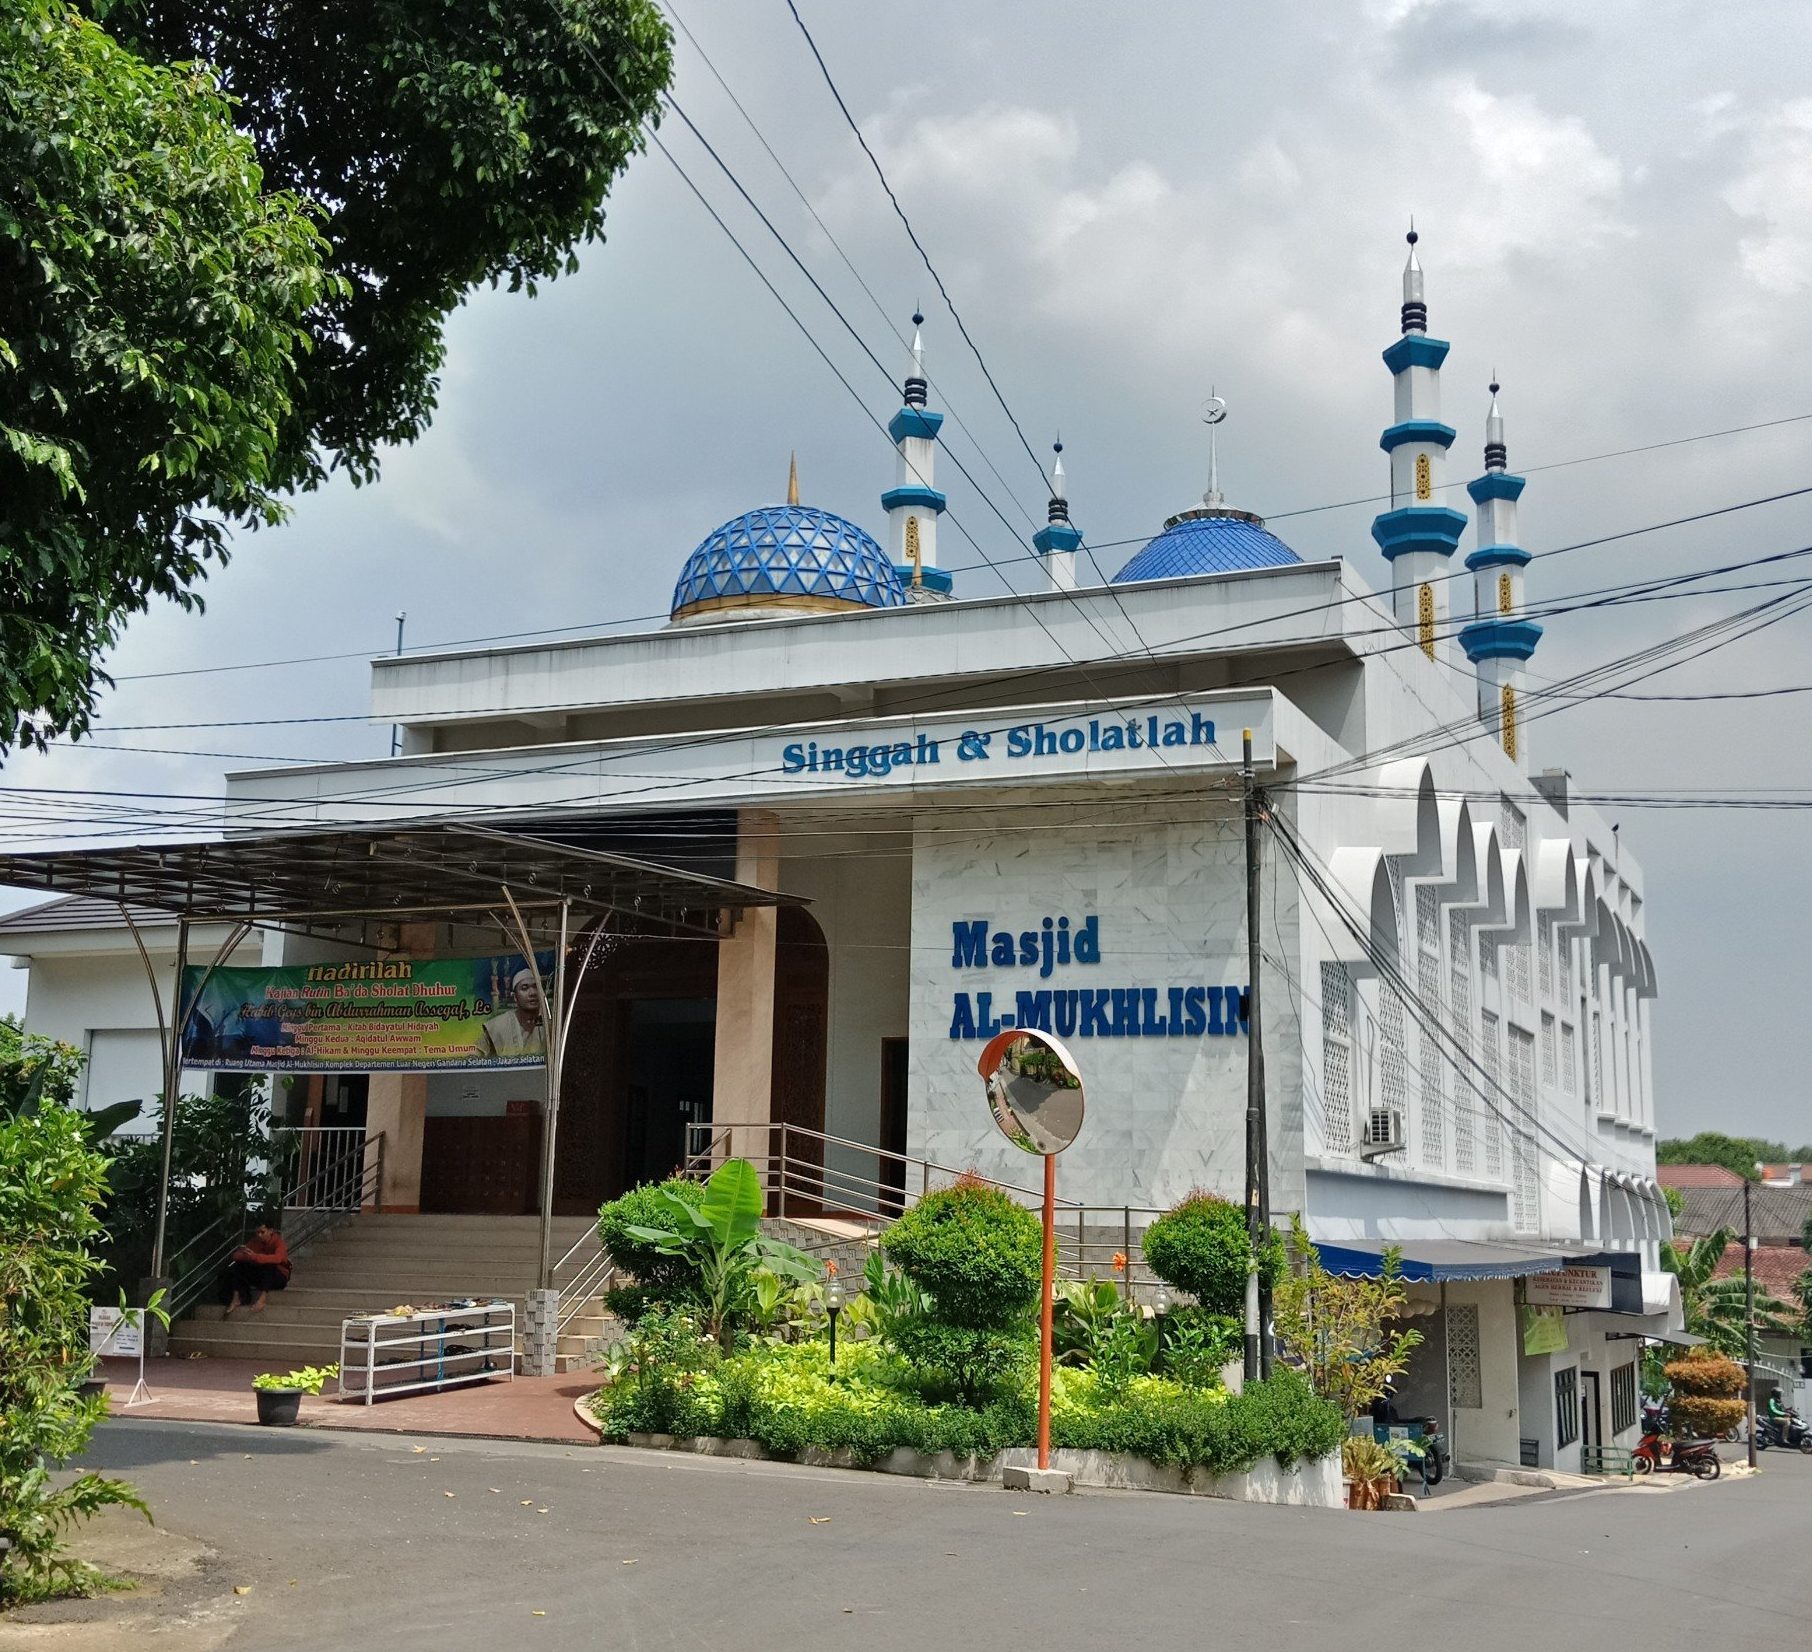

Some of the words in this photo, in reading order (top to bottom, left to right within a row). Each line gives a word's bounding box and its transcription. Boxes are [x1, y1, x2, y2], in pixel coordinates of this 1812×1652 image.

[783, 734, 939, 777] Singgah
[957, 731, 991, 762] &
[1008, 712, 1217, 758] Sholatlah
[952, 915, 1101, 978] Masjid
[266, 985, 300, 1001] Kajian
[302, 985, 330, 998] Rutin
[371, 983, 410, 997] Sholat
[412, 982, 457, 996] Dhuhur
[950, 985, 1250, 1039] AL-MUKHLISIN
[308, 1023, 341, 1032] Pertama
[347, 1023, 367, 1031] Kitab
[368, 1022, 405, 1032] Bidayatul
[407, 1022, 439, 1032] Hidayah
[296, 1035, 323, 1045] Minggu
[325, 1035, 349, 1043] Kedua
[356, 1034, 387, 1044] Aqidatul
[389, 1034, 421, 1043] Awwam
[306, 1045, 341, 1055] Al-Hikam
[351, 1046, 379, 1056] Minggu
[382, 1046, 416, 1056] Keempat
[424, 1045, 447, 1053] Tema
[448, 1045, 476, 1053] Umum
[355, 1060, 395, 1069] Departemen
